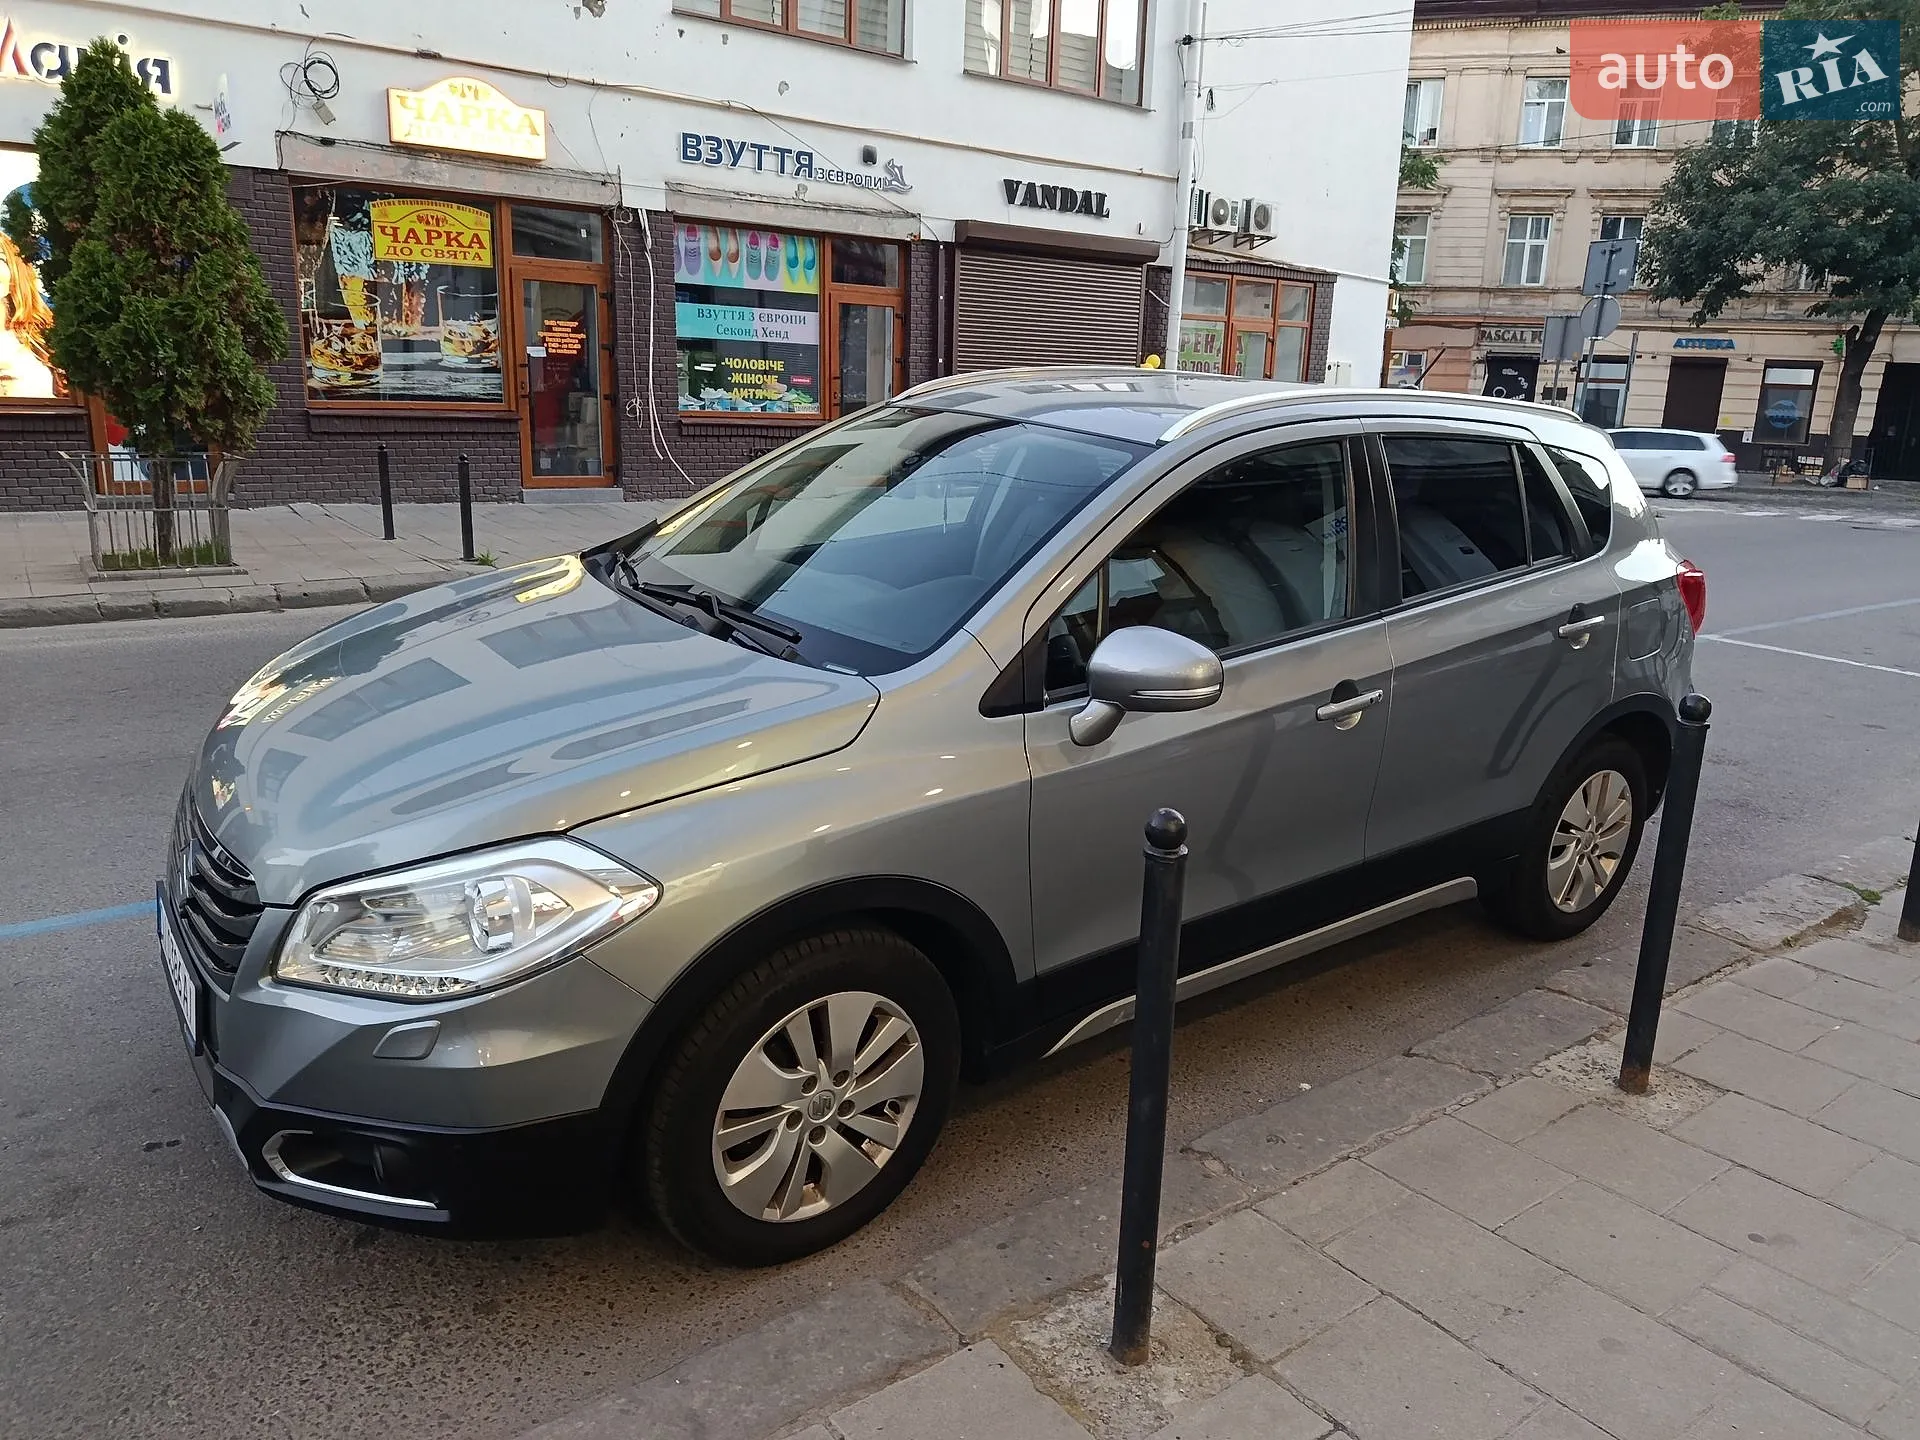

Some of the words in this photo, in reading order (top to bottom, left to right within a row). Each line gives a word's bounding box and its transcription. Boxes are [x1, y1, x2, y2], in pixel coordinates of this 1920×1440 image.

[397, 95, 540, 136] ЧАРКА
[681, 132, 814, 179] ВЗУТТЯ
[1003, 178, 1110, 219] VANDAL
[378, 225, 487, 250] ЧАРКА
[384, 245, 413, 257] ДО
[421, 248, 483, 262] СВЯТА
[697, 308, 745, 321] ВЗУТТЯ
[758, 313, 806, 325] ЄВРОПИ
[716, 324, 758, 338] Секонд
[761, 327, 789, 340] Хенд
[1480, 330, 1528, 341] PASCAL
